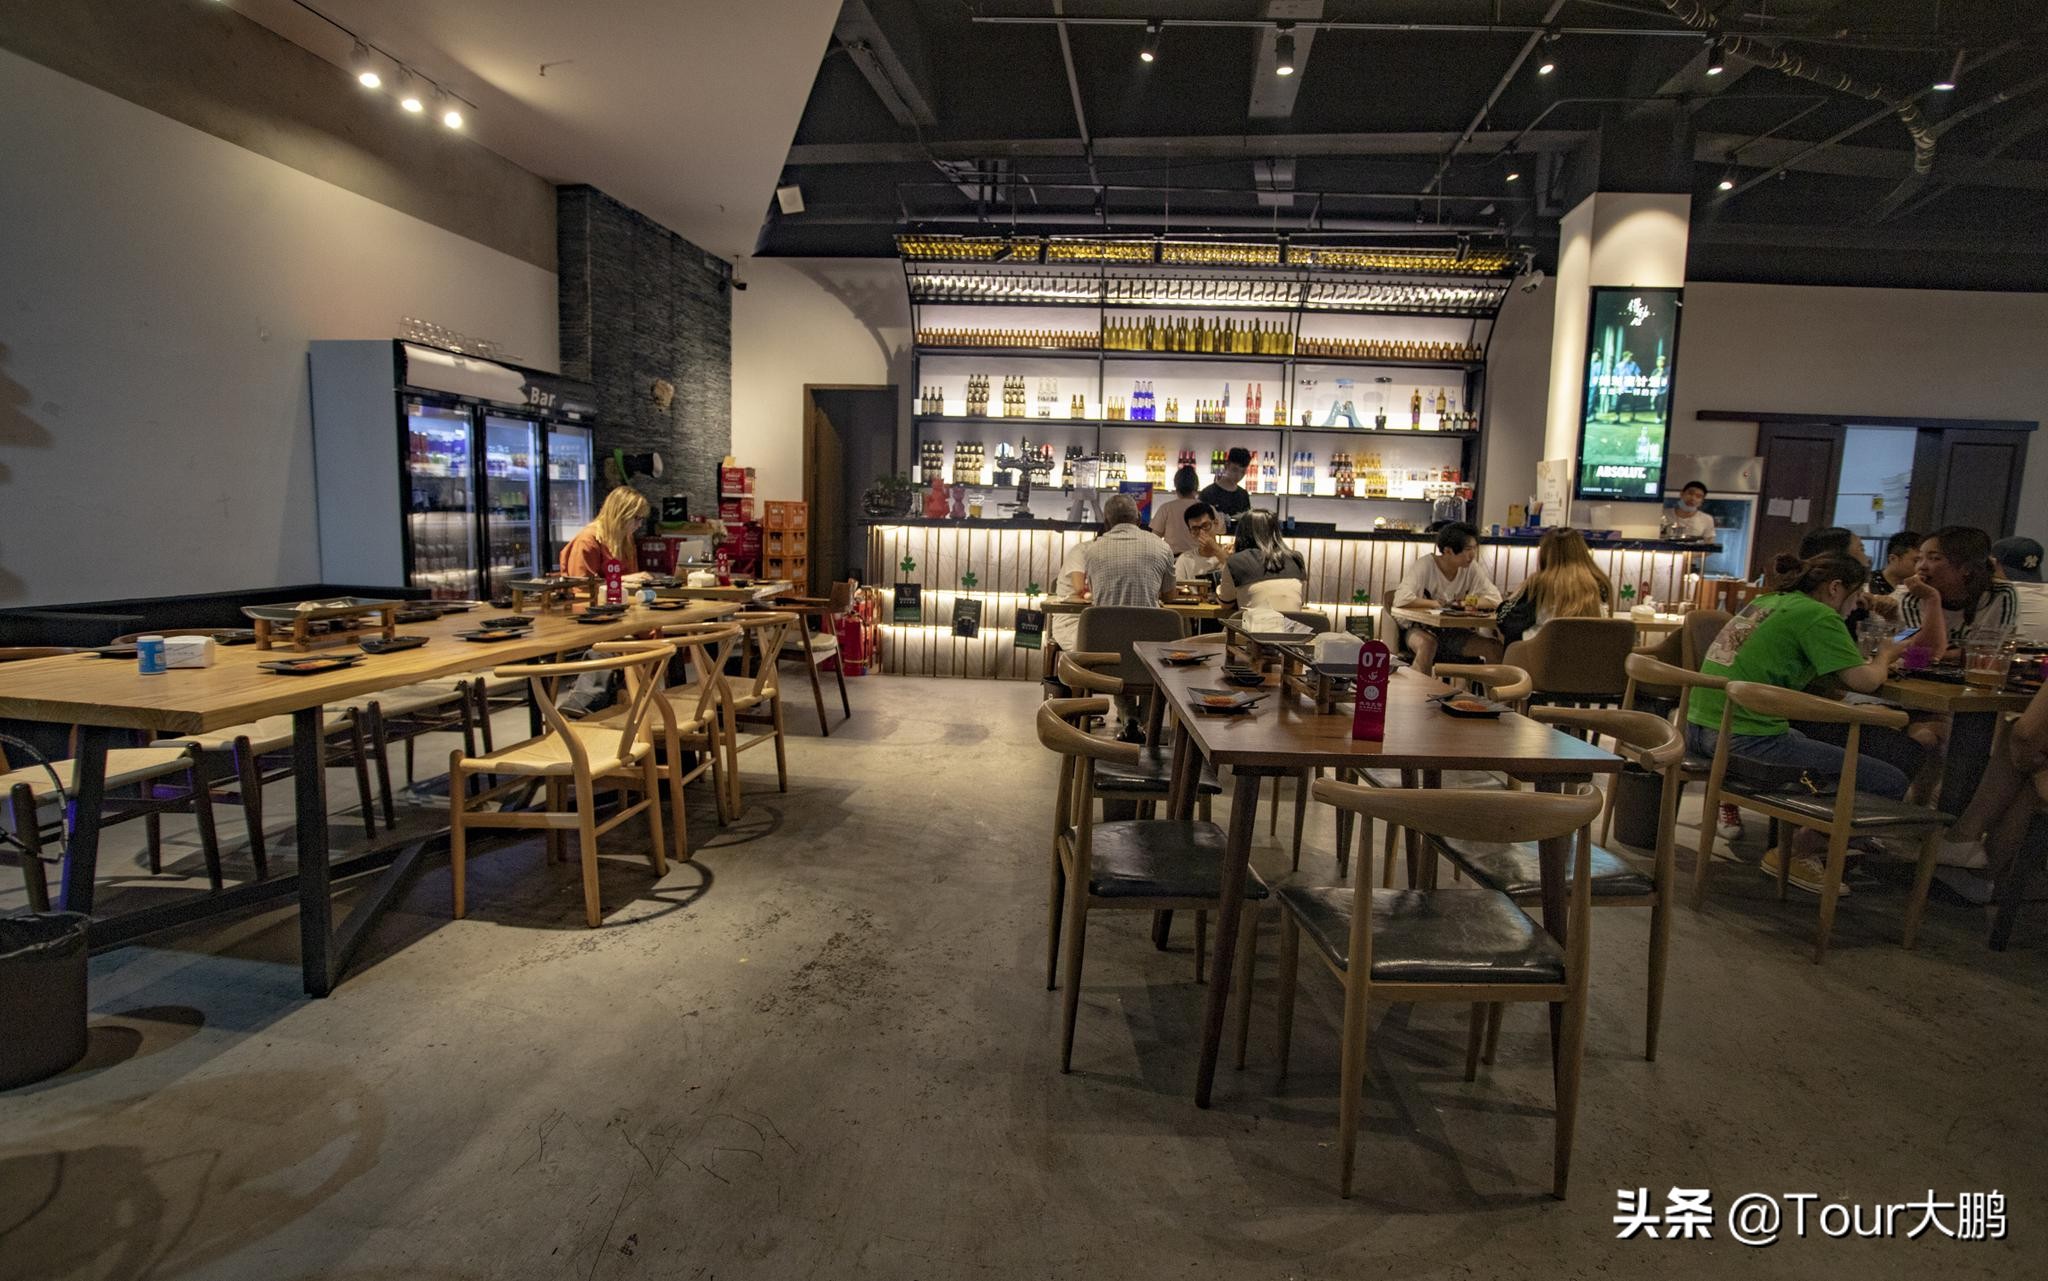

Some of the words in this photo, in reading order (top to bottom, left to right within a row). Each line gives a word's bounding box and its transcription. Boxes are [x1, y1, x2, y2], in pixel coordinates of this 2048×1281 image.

[530, 386, 556, 407] Bar
[607, 564, 621, 573] 06
[1362, 651, 1387, 668] 07
